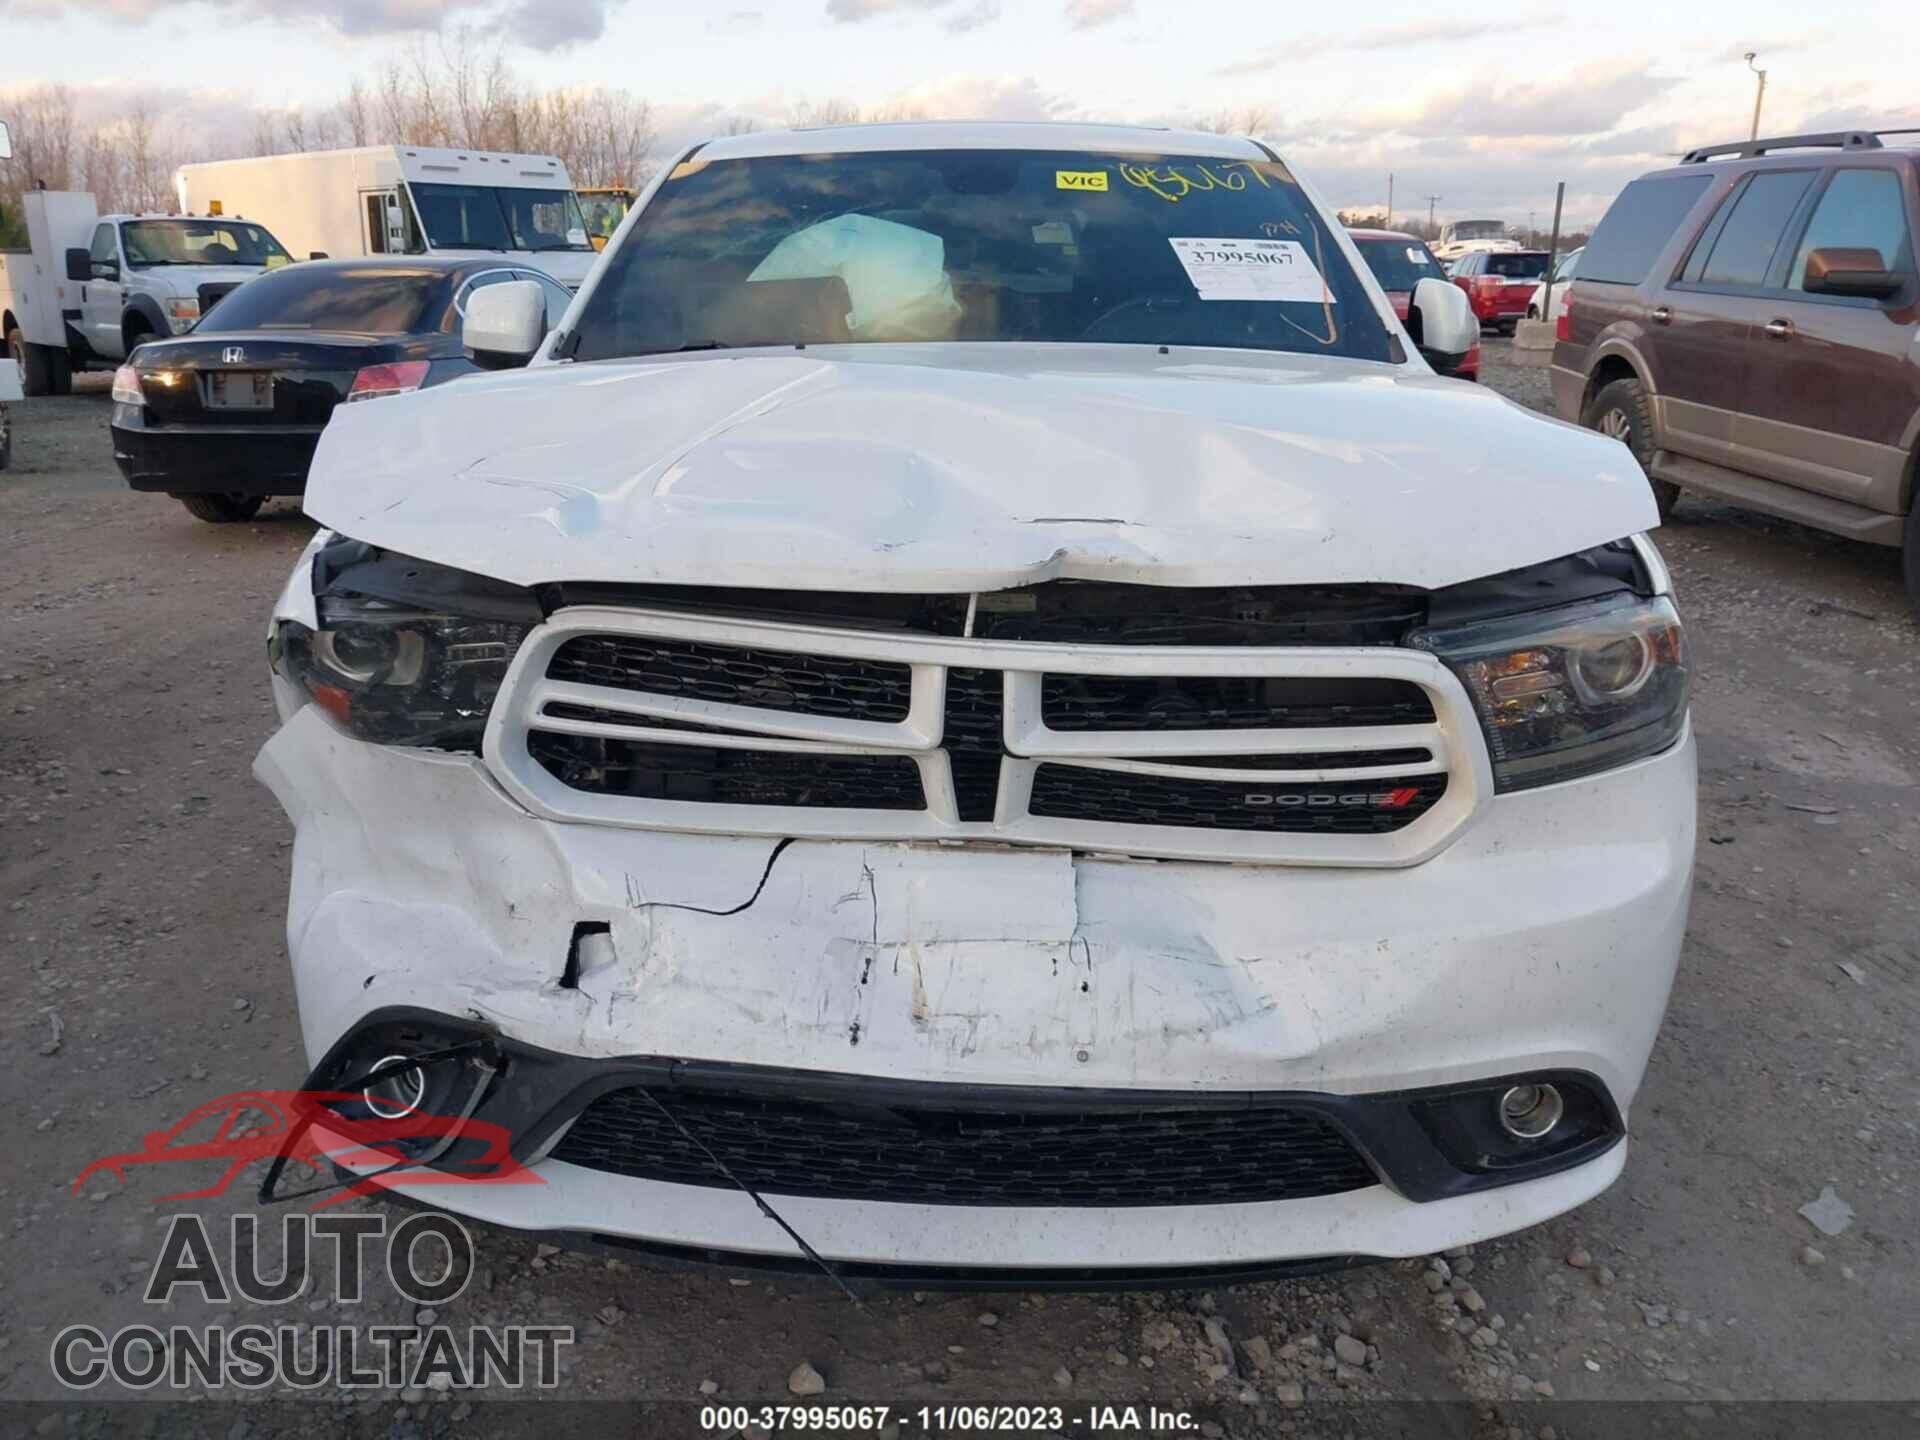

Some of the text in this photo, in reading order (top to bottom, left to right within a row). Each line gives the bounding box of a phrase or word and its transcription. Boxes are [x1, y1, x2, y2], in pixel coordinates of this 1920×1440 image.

[1062, 175, 1104, 187] VIC
[1191, 250, 1294, 265] 37995067
[1244, 793, 1396, 806] DODGE
